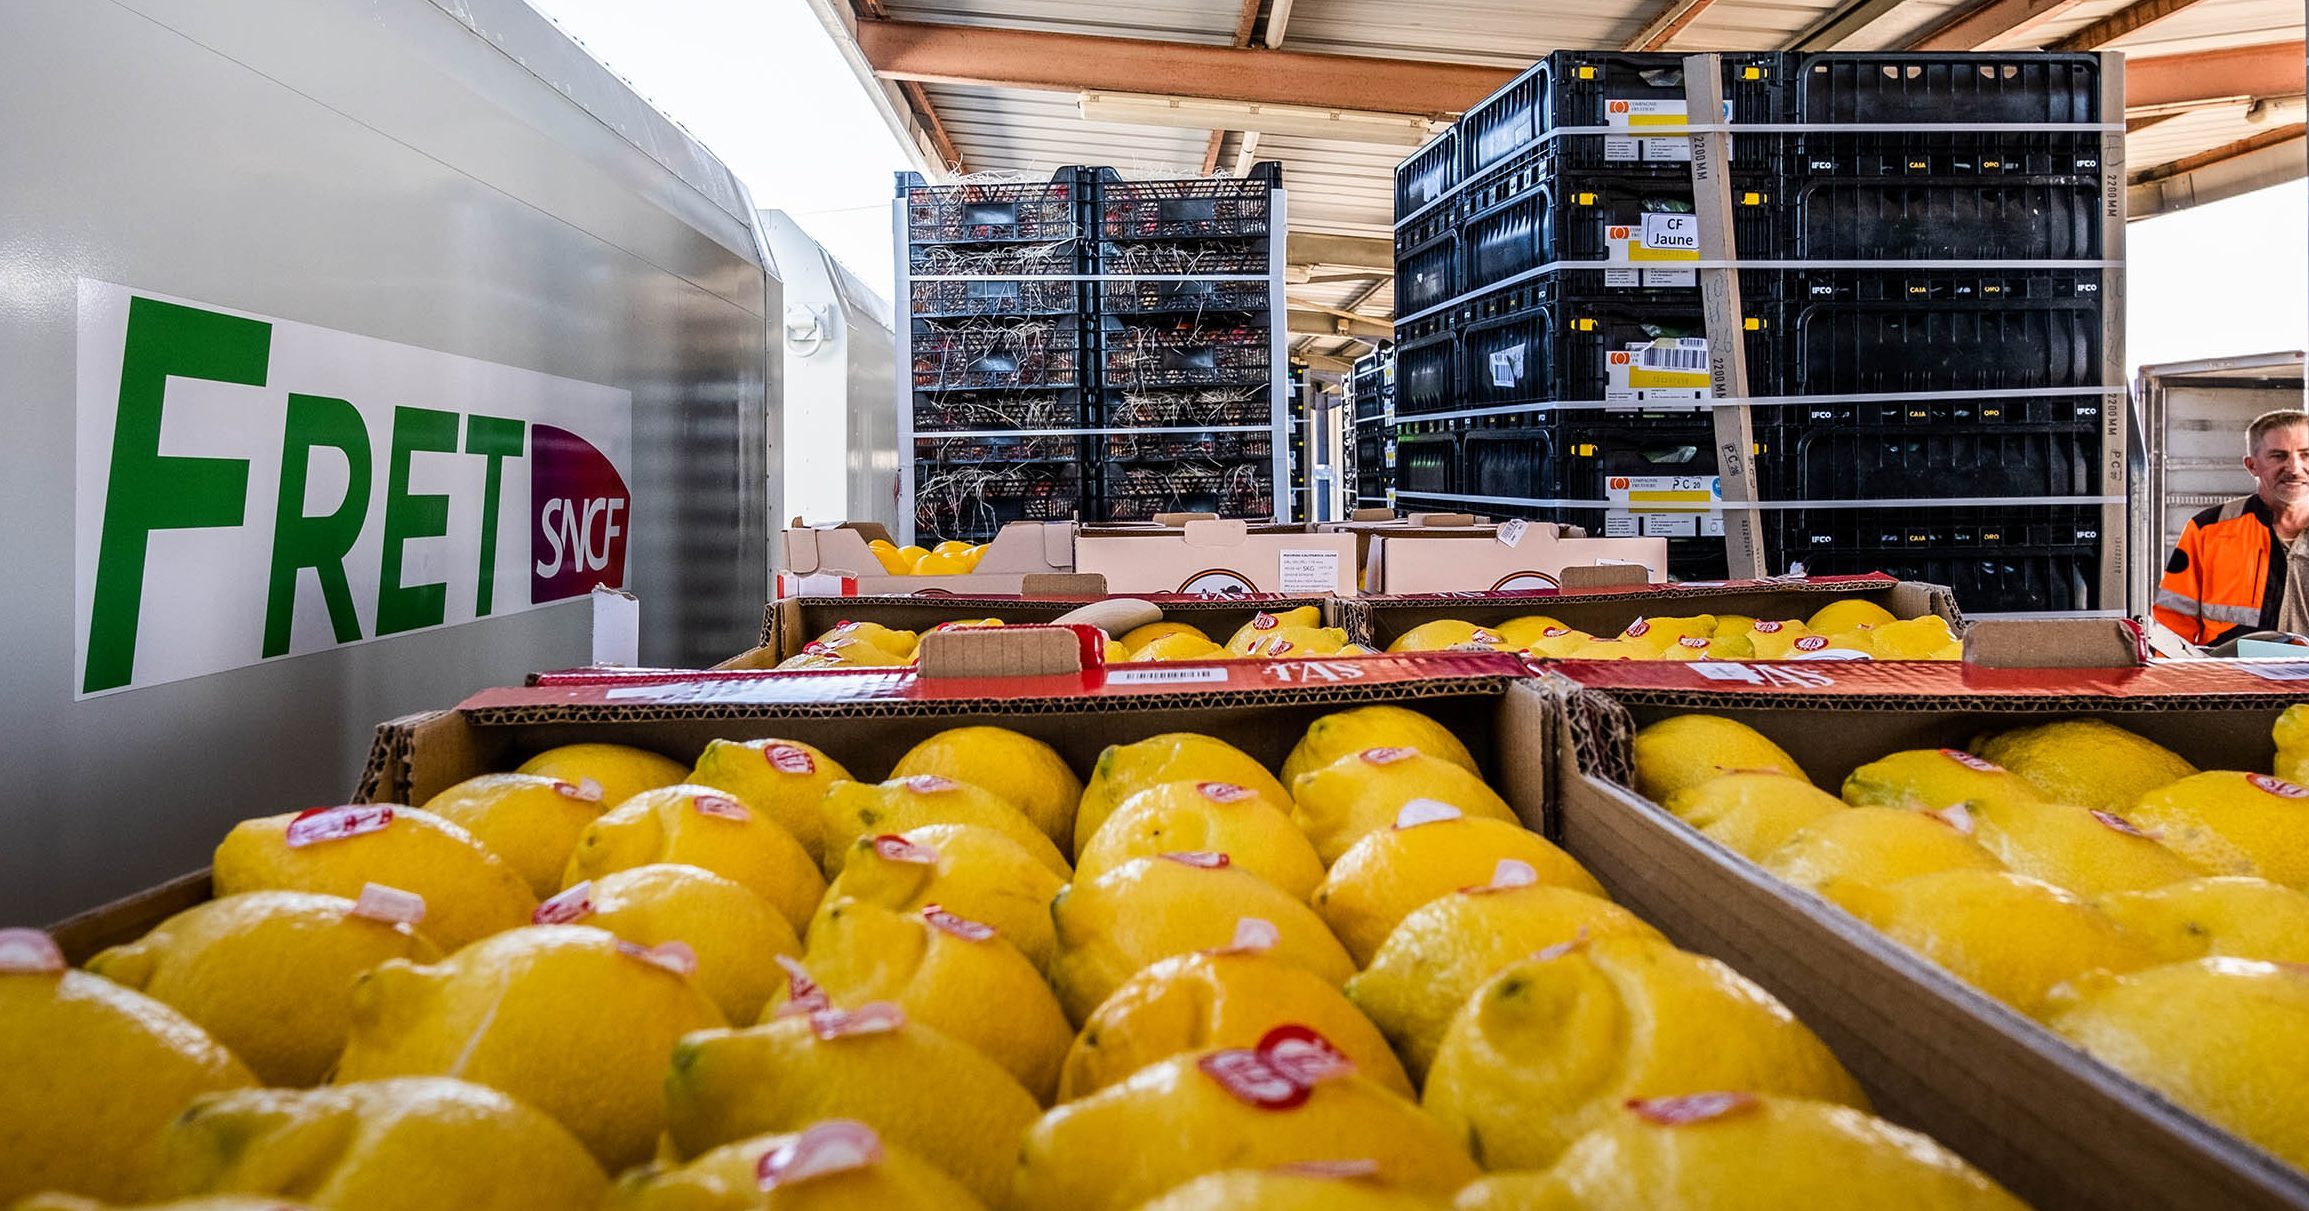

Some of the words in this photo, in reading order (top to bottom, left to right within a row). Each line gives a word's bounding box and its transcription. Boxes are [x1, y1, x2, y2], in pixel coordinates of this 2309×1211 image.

[1811, 161, 1832, 170] IFCO
[2076, 160, 2097, 168] IFCO
[1667, 218, 1683, 230] CF
[1654, 233, 1694, 246] Jaune
[1811, 285, 1832, 294] IFCO
[2077, 283, 2098, 292] IFCO
[1811, 410, 1832, 419] IFCO
[2076, 407, 2097, 415] IFCO
[536, 497, 625, 580] SNCF
[1811, 535, 1832, 543] IFCO
[2076, 530, 2097, 539] IFCO
